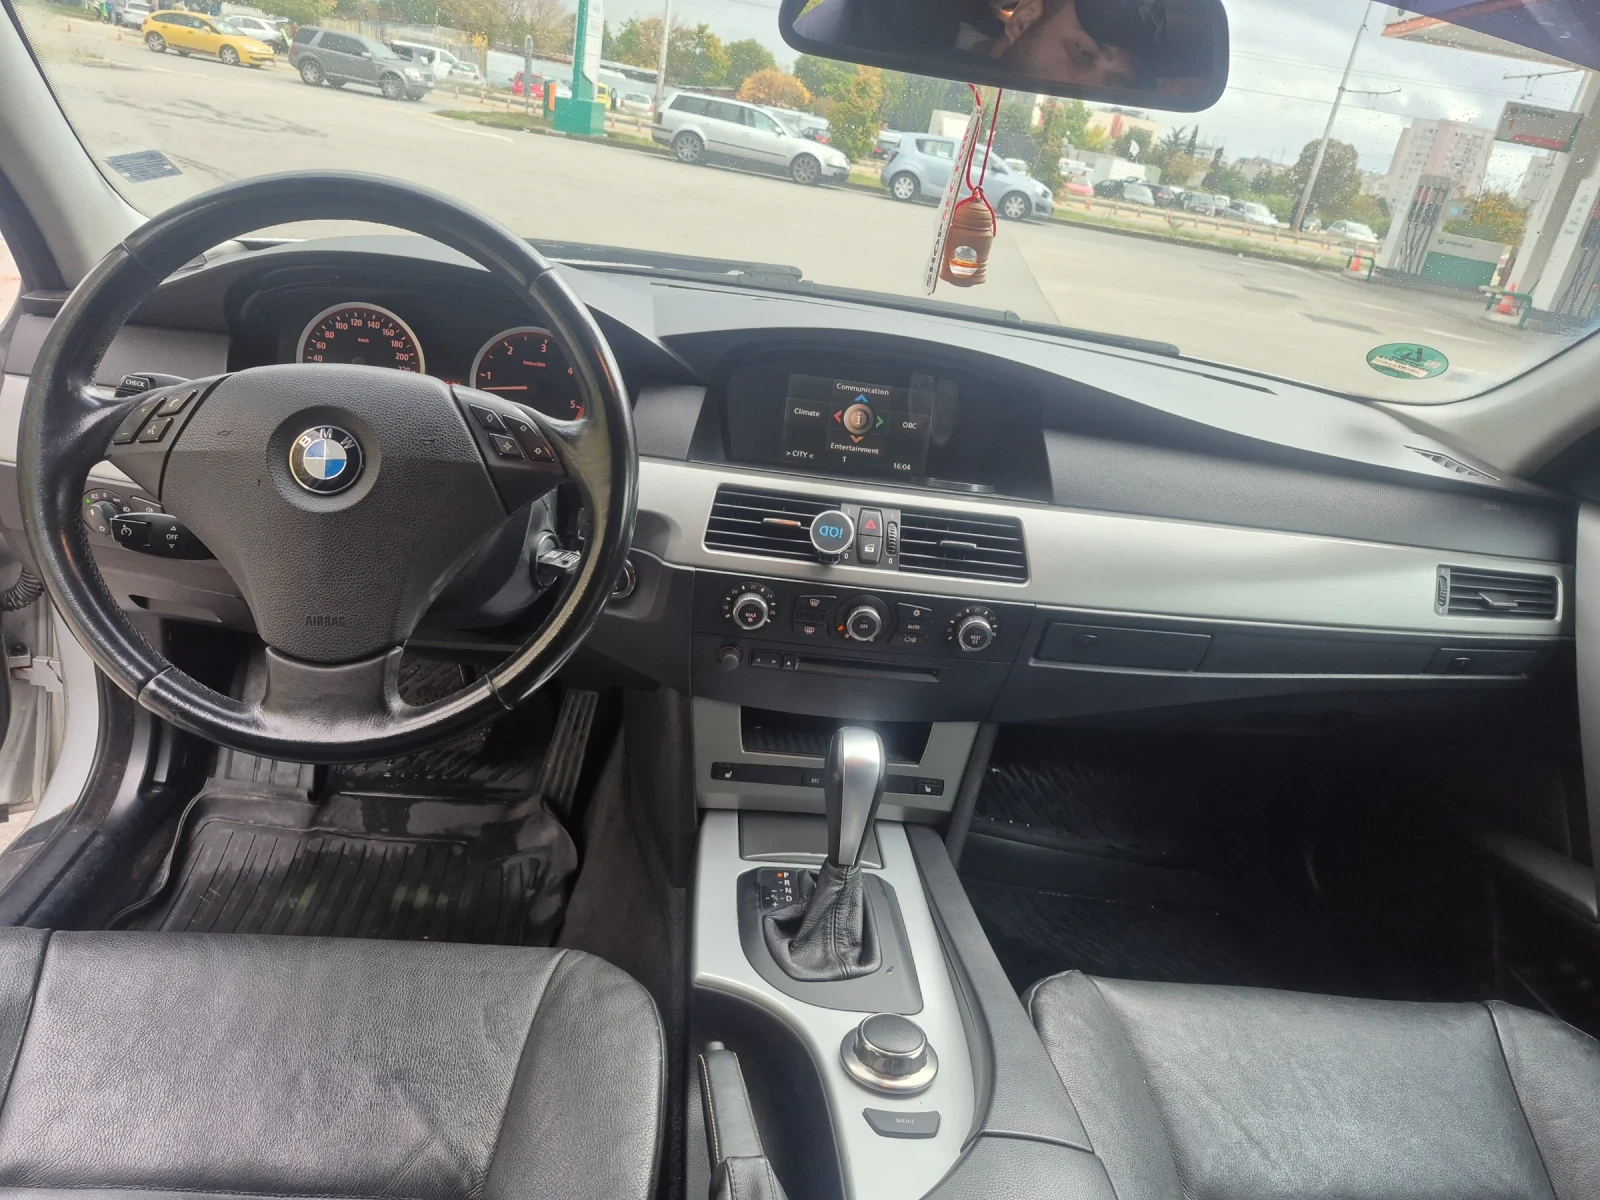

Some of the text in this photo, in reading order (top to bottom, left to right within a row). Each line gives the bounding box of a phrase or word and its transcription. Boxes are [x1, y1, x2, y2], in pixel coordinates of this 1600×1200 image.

[335, 321, 348, 330] 100
[350, 318, 362, 327] 120
[367, 320, 380, 329] 140
[324, 330, 334, 339] 80
[382, 328, 394, 337] 160
[316, 341, 326, 350] 60
[391, 340, 403, 348] 180
[540, 344, 547, 353] 3
[507, 346, 514, 355] 2
[313, 354, 322, 362] 40
[395, 353, 409, 361] 200
[486, 371, 491, 380] 1
[567, 367, 573, 375] 4
[125, 379, 145, 388] CHECK
[836, 382, 890, 396] Communication
[570, 400, 576, 409] 5
[794, 407, 821, 417] Climate
[902, 421, 917, 429] OBC
[299, 428, 355, 450] BMW
[830, 442, 880, 455] Entertainment
[792, 450, 808, 458] CITY
[893, 462, 911, 471] 16:04
[305, 615, 346, 627] AIRBAG
